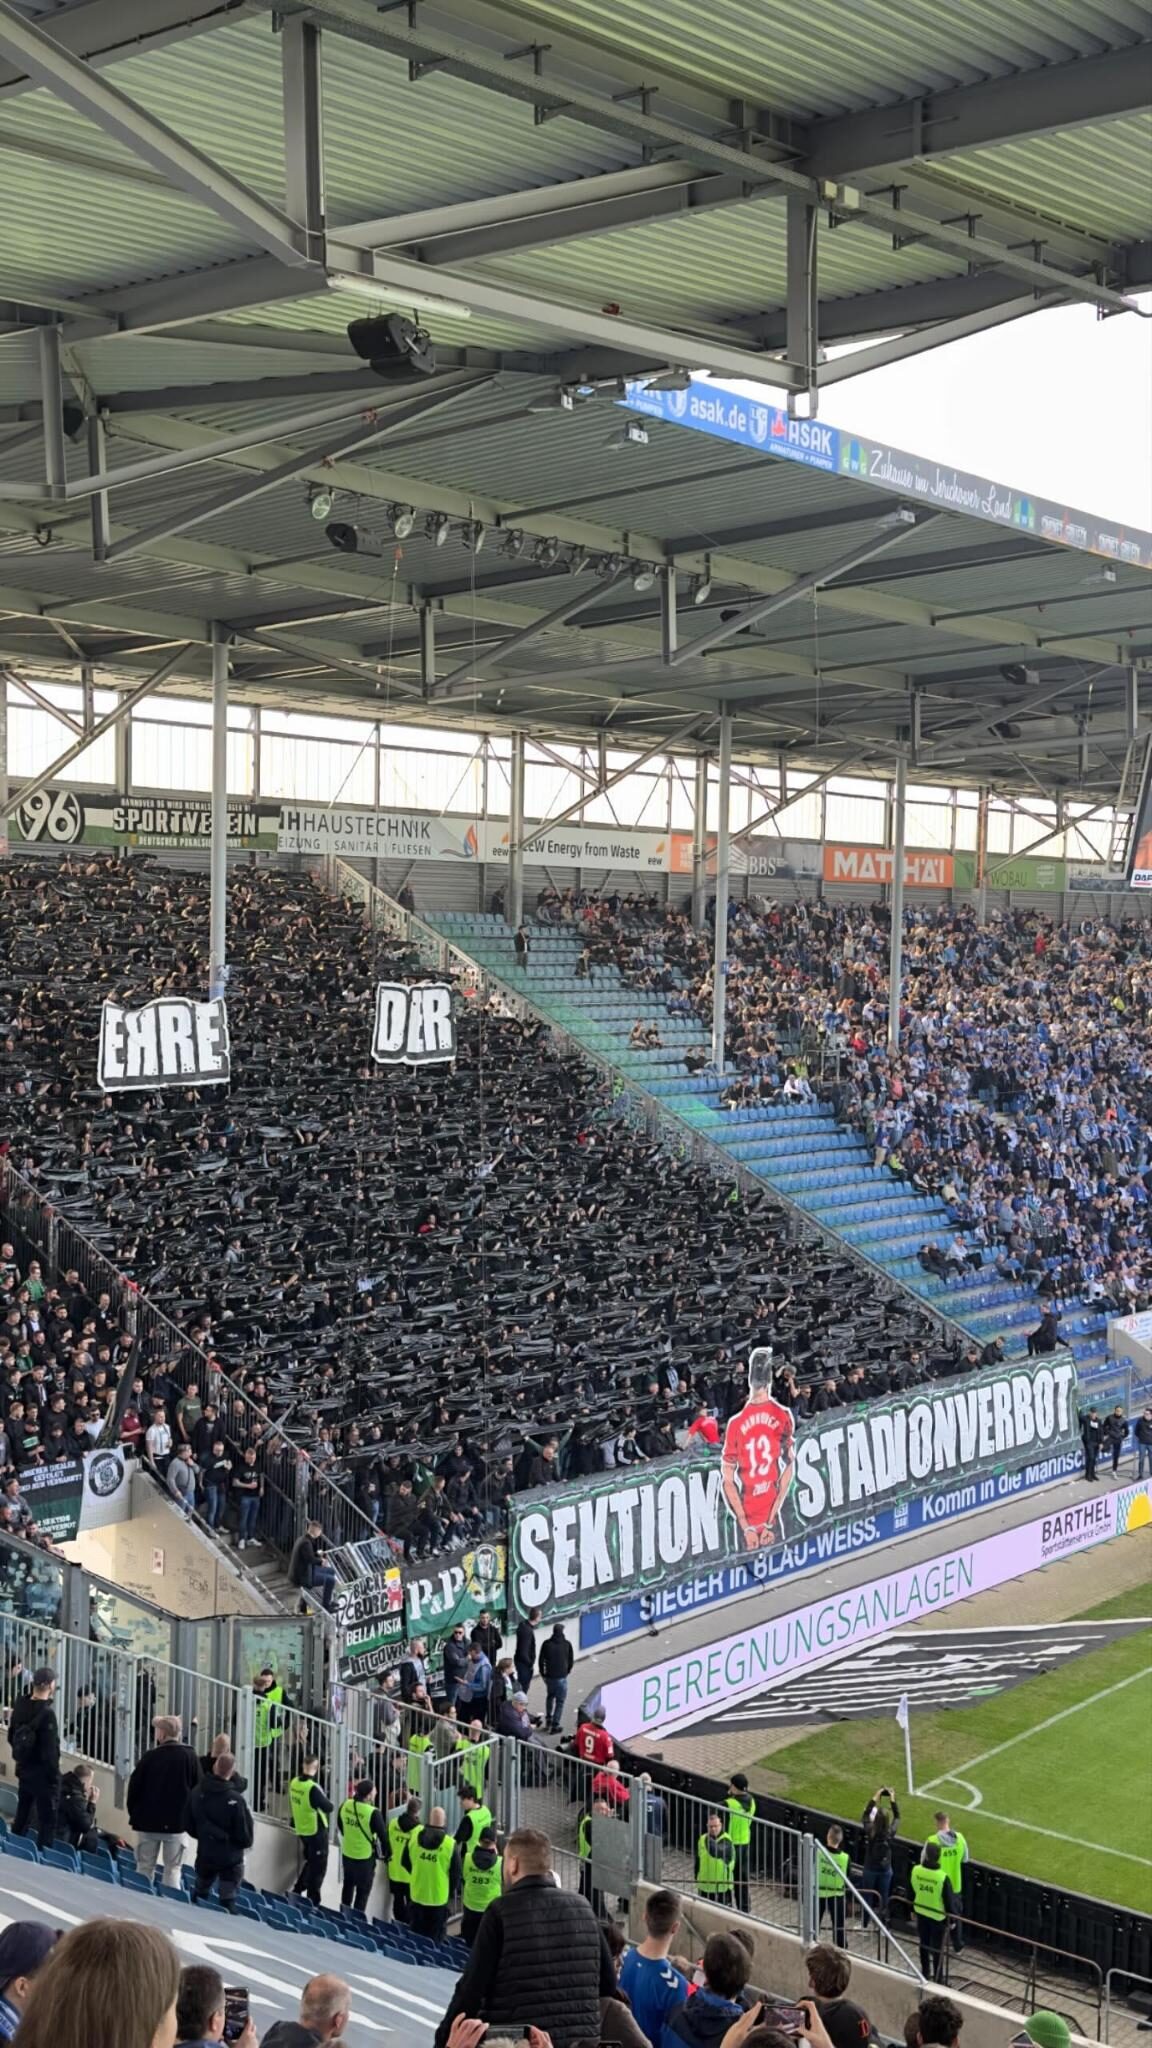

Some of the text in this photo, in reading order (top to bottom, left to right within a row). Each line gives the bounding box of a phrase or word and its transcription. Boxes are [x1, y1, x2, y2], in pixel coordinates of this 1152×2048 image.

[690, 395, 746, 433] asak.de
[788, 421, 832, 456] ASAK
[870, 450, 913, 488] Zuhause
[981, 484, 1012, 521] Land
[22, 788, 79, 844] 96
[113, 808, 256, 835] SPORTVEEIN
[303, 811, 431, 839] HAUSTECHNIK
[278, 836, 321, 850] EIZUNG
[392, 843, 432, 856] FLIESEN
[548, 840, 583, 859] Energy
[585, 841, 609, 857] from
[611, 844, 641, 859] Waste
[648, 857, 662, 866] eew
[749, 856, 777, 877] BBS
[991, 869, 1028, 888] WOBAU
[377, 988, 452, 1053] DER
[103, 1003, 223, 1079] EHRE
[745, 1434, 773, 1479] 13
[519, 1365, 1074, 1608] SEKTION STADIONVERBOT
[921, 1491, 976, 1523] Komm
[998, 1468, 1022, 1495] die
[1041, 1498, 1111, 1544] BARTHEL
[639, 1570, 725, 1621] SIEGER
[346, 1616, 402, 1647] BELLA VISTA
[642, 1552, 974, 1722] BEREGNUNGSANLAGEN
[584, 1735, 595, 1754] 9
[419, 1851, 437, 1863] 446
[472, 1876, 490, 1885] 283
